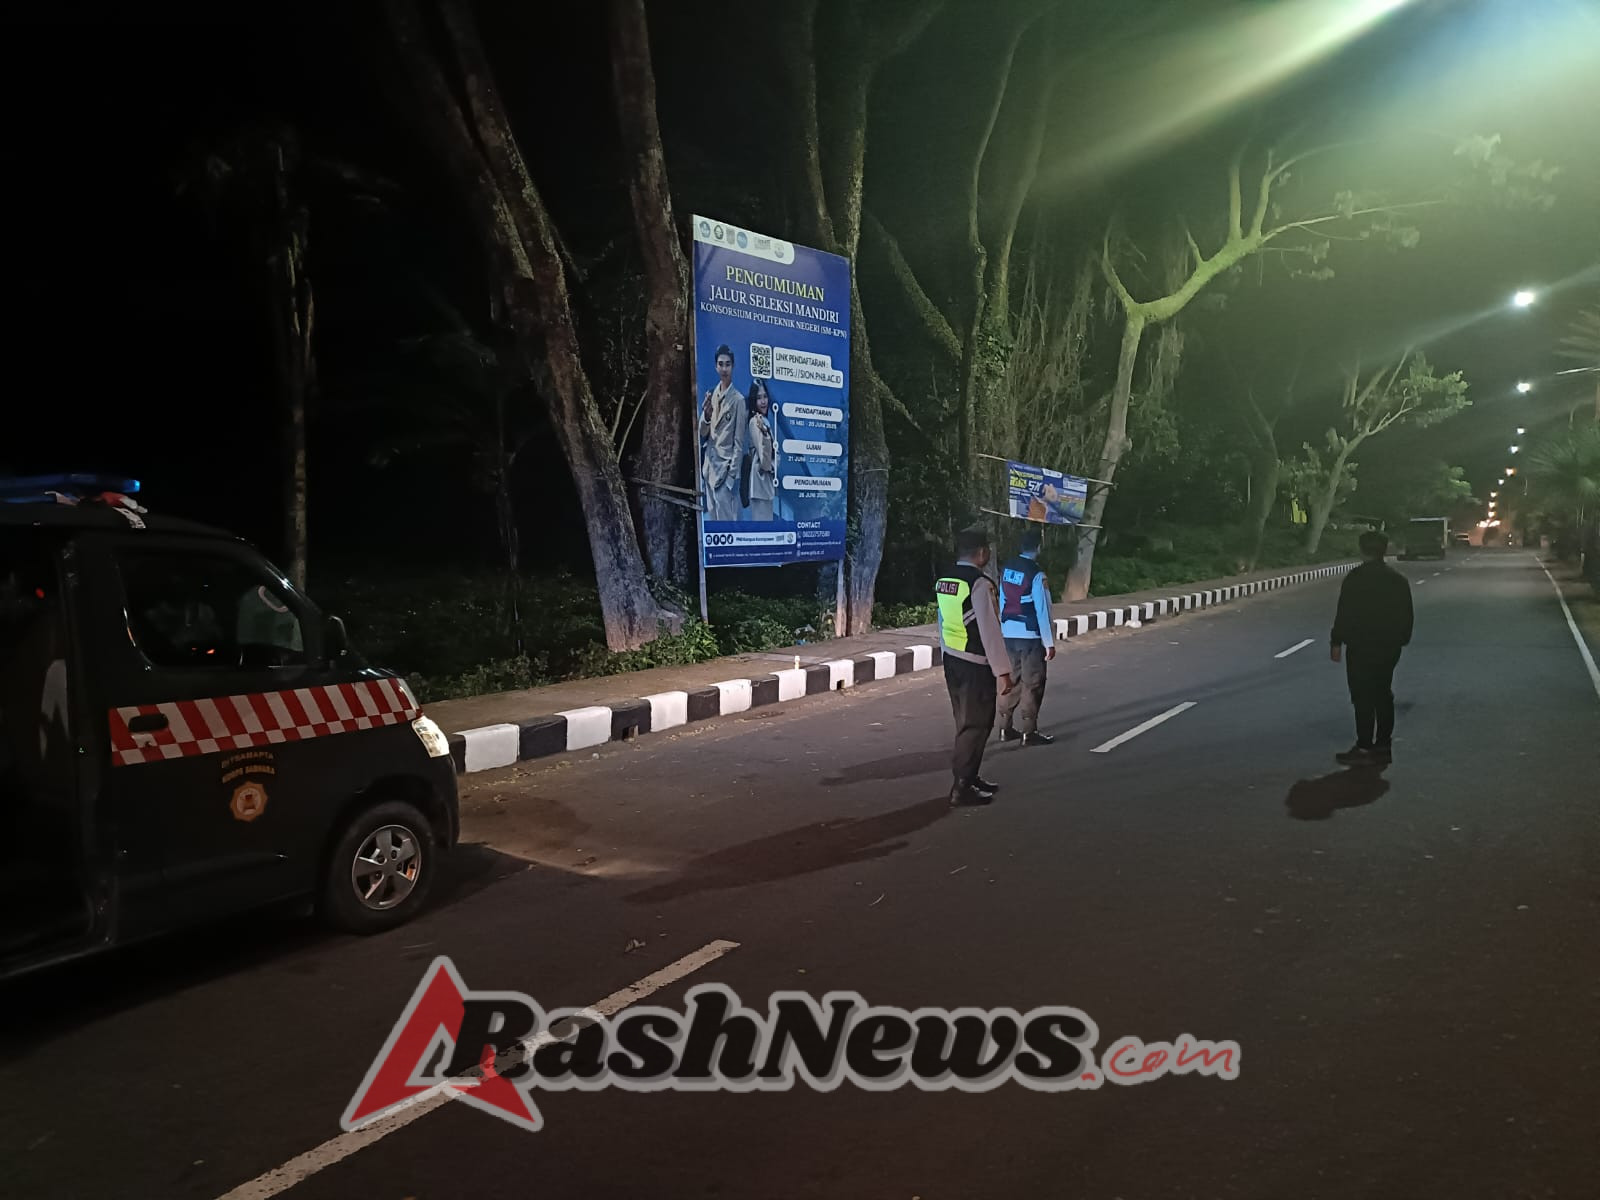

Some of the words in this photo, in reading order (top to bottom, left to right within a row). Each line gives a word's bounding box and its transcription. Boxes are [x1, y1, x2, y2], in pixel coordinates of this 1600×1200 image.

[726, 265, 824, 302] PENGUMUMAN
[709, 285, 746, 305] JALUR
[749, 293, 793, 314] SELEKSI
[795, 304, 839, 324] MANDIRI
[700, 302, 752, 320] KONSORSIUM
[753, 312, 795, 328] POLITEKNIK
[796, 320, 820, 333] NEGERI
[820, 325, 847, 339] (SM-KPN)
[776, 353, 788, 362] LINK
[794, 406, 832, 417] PENDAFTARAN
[794, 478, 832, 487] PENGUMUMAN
[797, 521, 821, 529] CONTACT
[937, 581, 958, 594] POLISI
